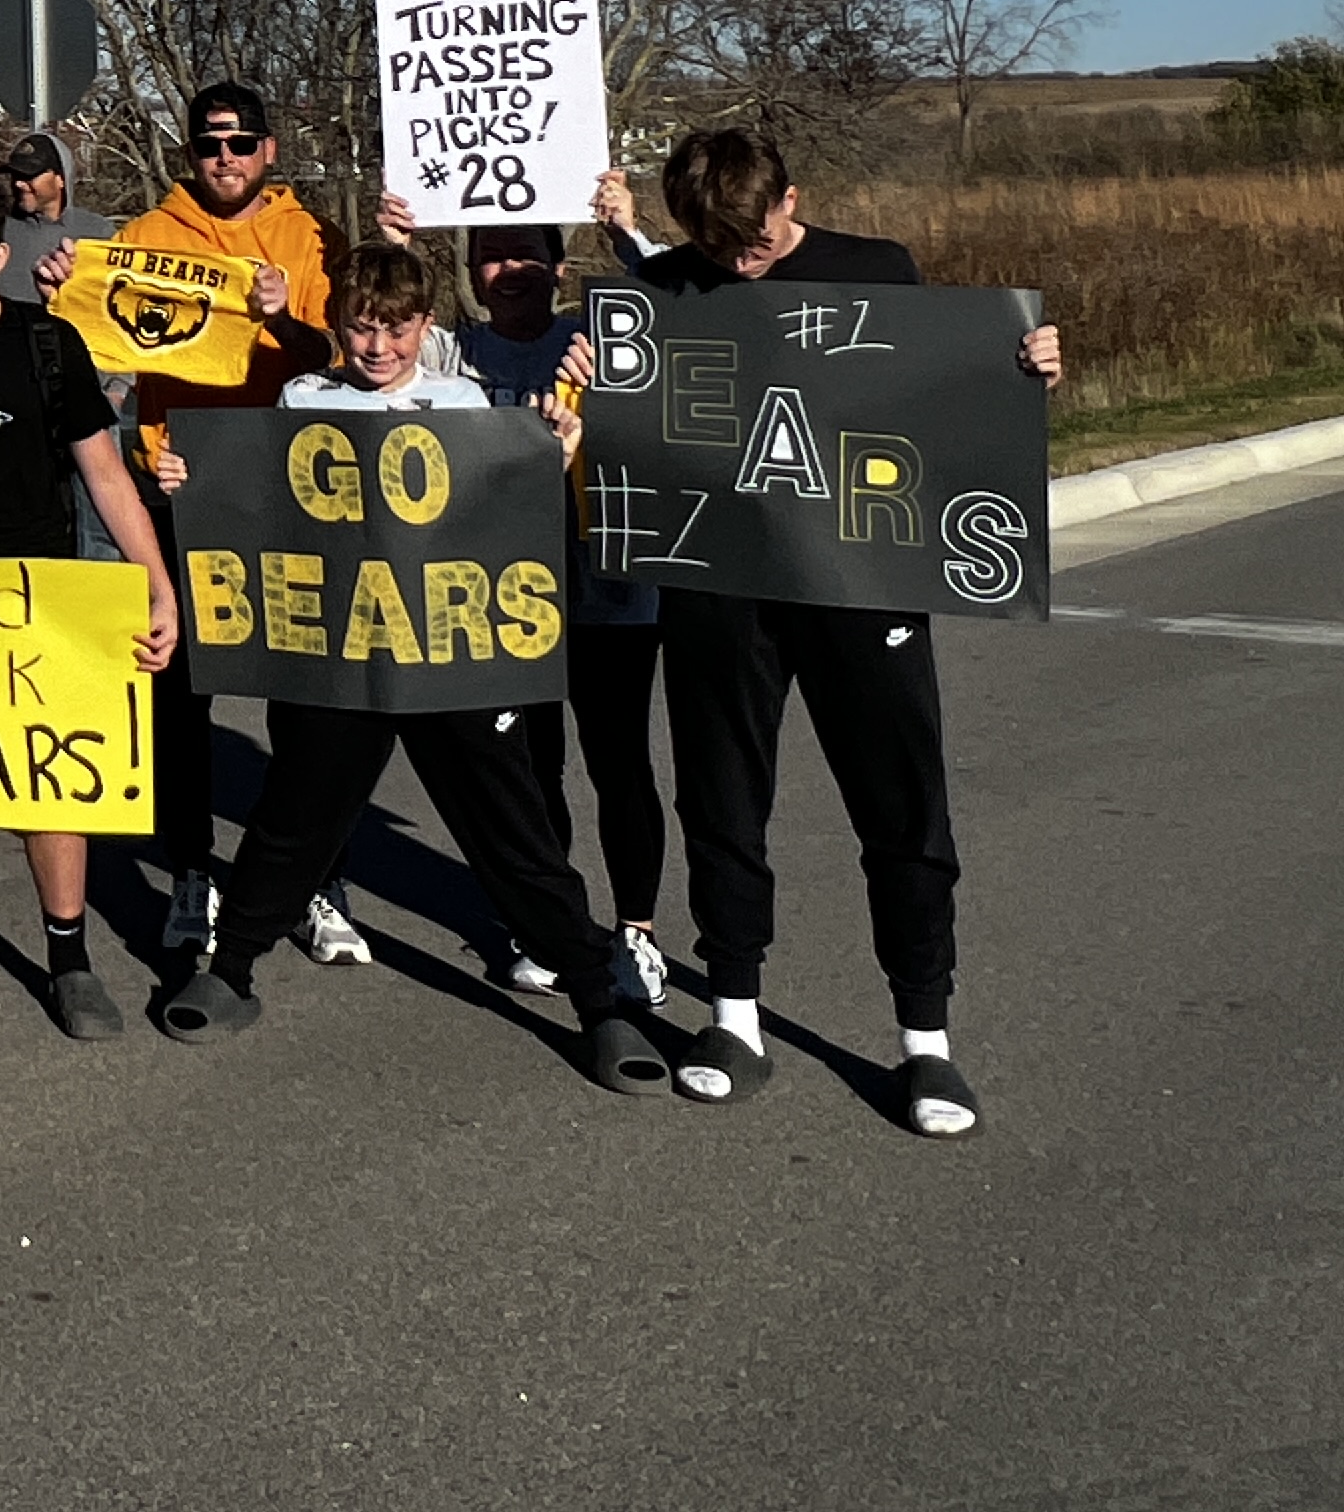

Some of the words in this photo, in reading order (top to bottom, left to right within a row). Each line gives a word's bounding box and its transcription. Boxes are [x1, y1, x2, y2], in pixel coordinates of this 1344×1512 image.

[389, 38, 554, 93] PASSES
[444, 85, 532, 115] INTO
[409, 101, 559, 157] PICKS!
[417, 153, 537, 212] #28
[106, 246, 135, 267] GO
[142, 251, 229, 288] BEARS!
[288, 422, 451, 526] GO
[589, 288, 1028, 604] BEARS
[186, 549, 562, 665] BEARS
